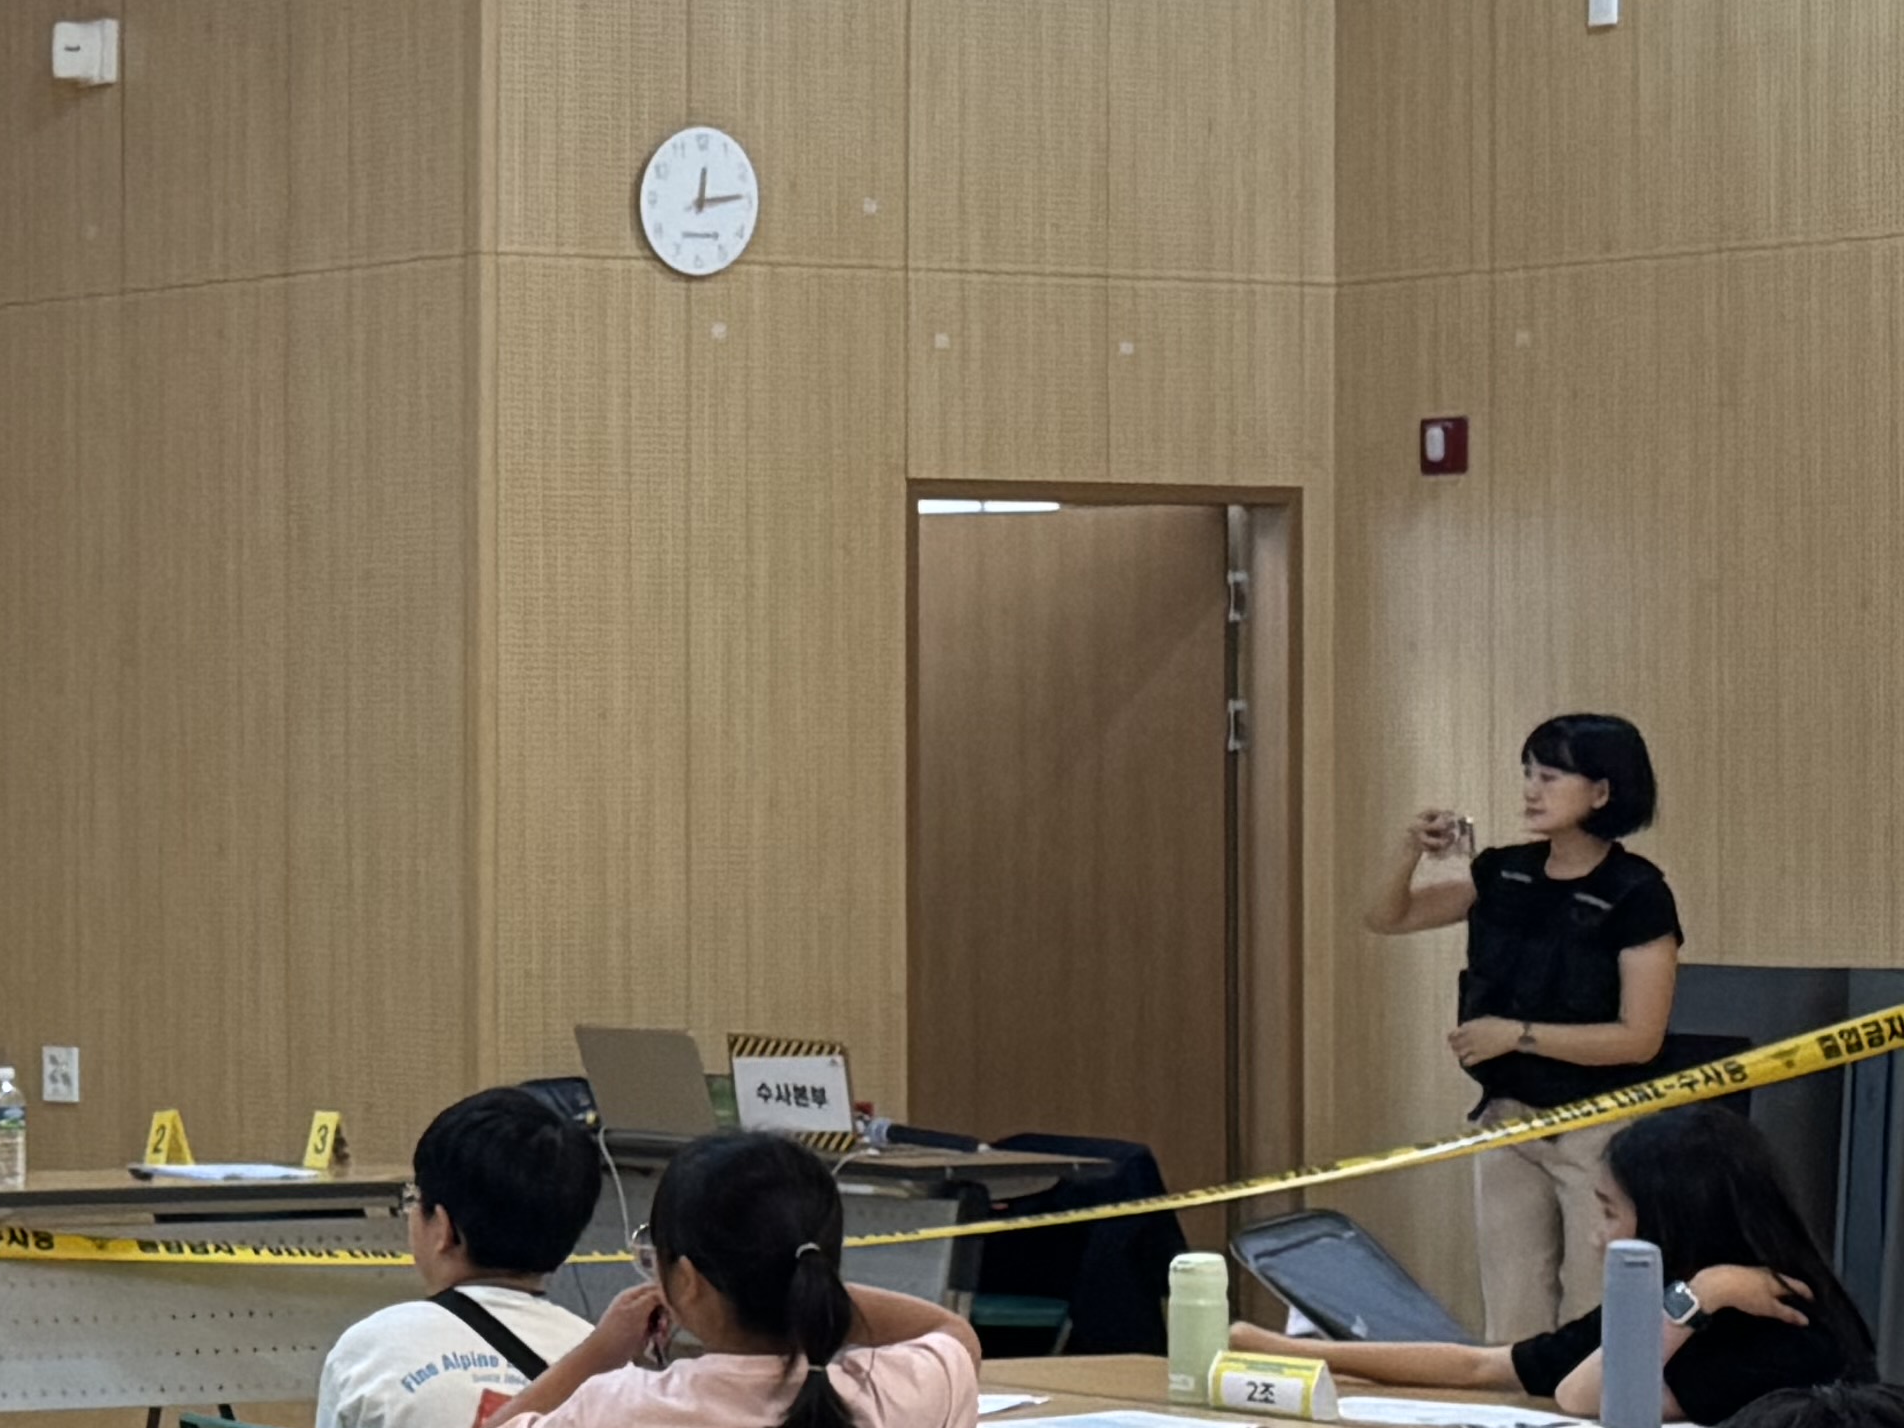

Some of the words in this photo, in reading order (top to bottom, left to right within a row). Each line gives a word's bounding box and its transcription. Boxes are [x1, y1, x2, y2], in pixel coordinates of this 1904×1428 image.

[756, 1081, 829, 1109] 수사본부
[152, 1123, 168, 1155] 2
[314, 1123, 329, 1156] 3
[441, 1350, 500, 1371] Alpine
[1245, 1380, 1277, 1405] 2조
